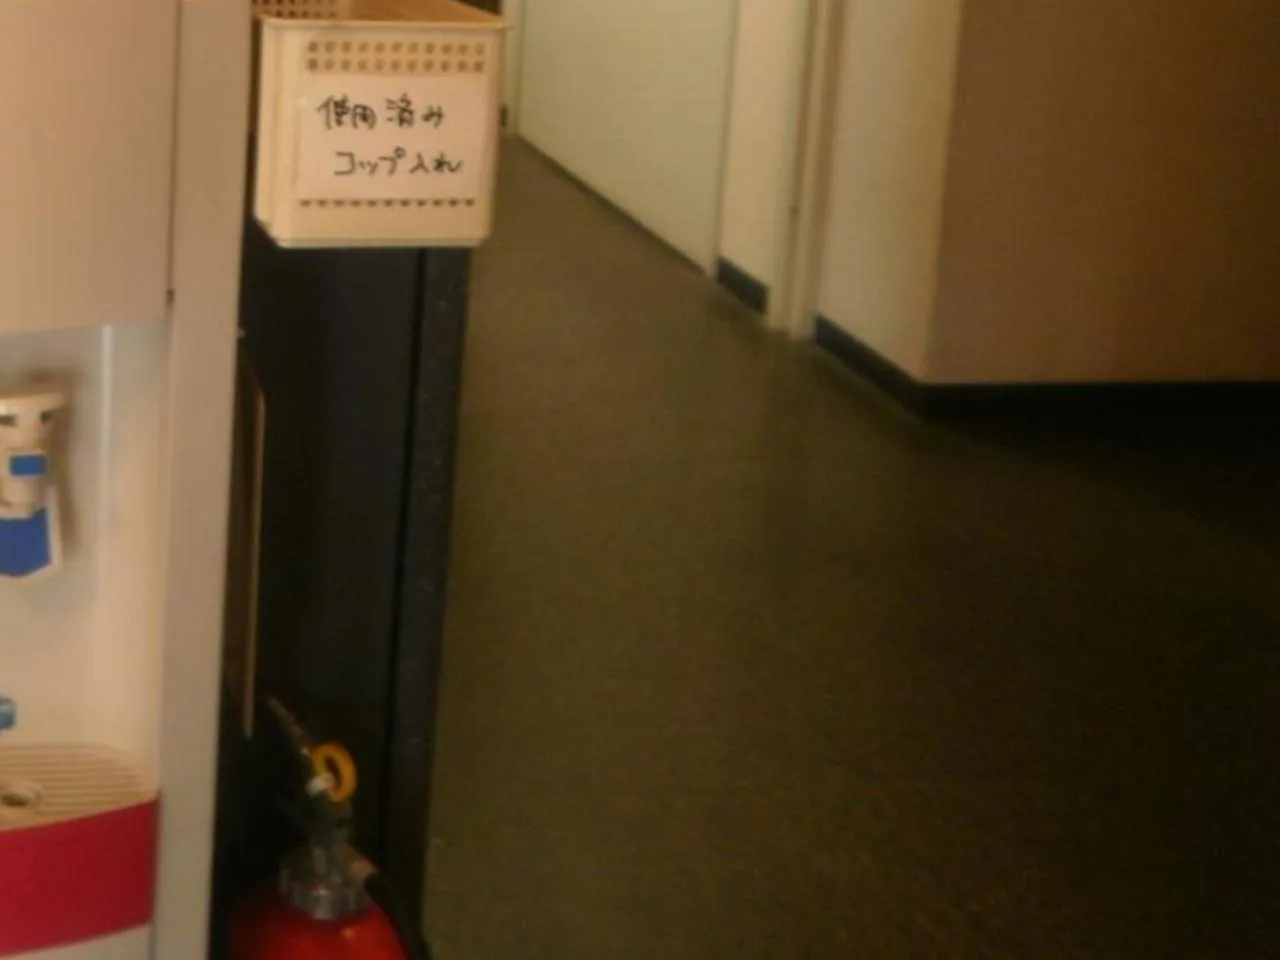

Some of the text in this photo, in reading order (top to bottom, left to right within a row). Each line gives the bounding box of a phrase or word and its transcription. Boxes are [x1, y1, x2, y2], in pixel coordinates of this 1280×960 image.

[318, 93, 445, 130] 使用済み
[333, 146, 463, 176] コップ入れ
